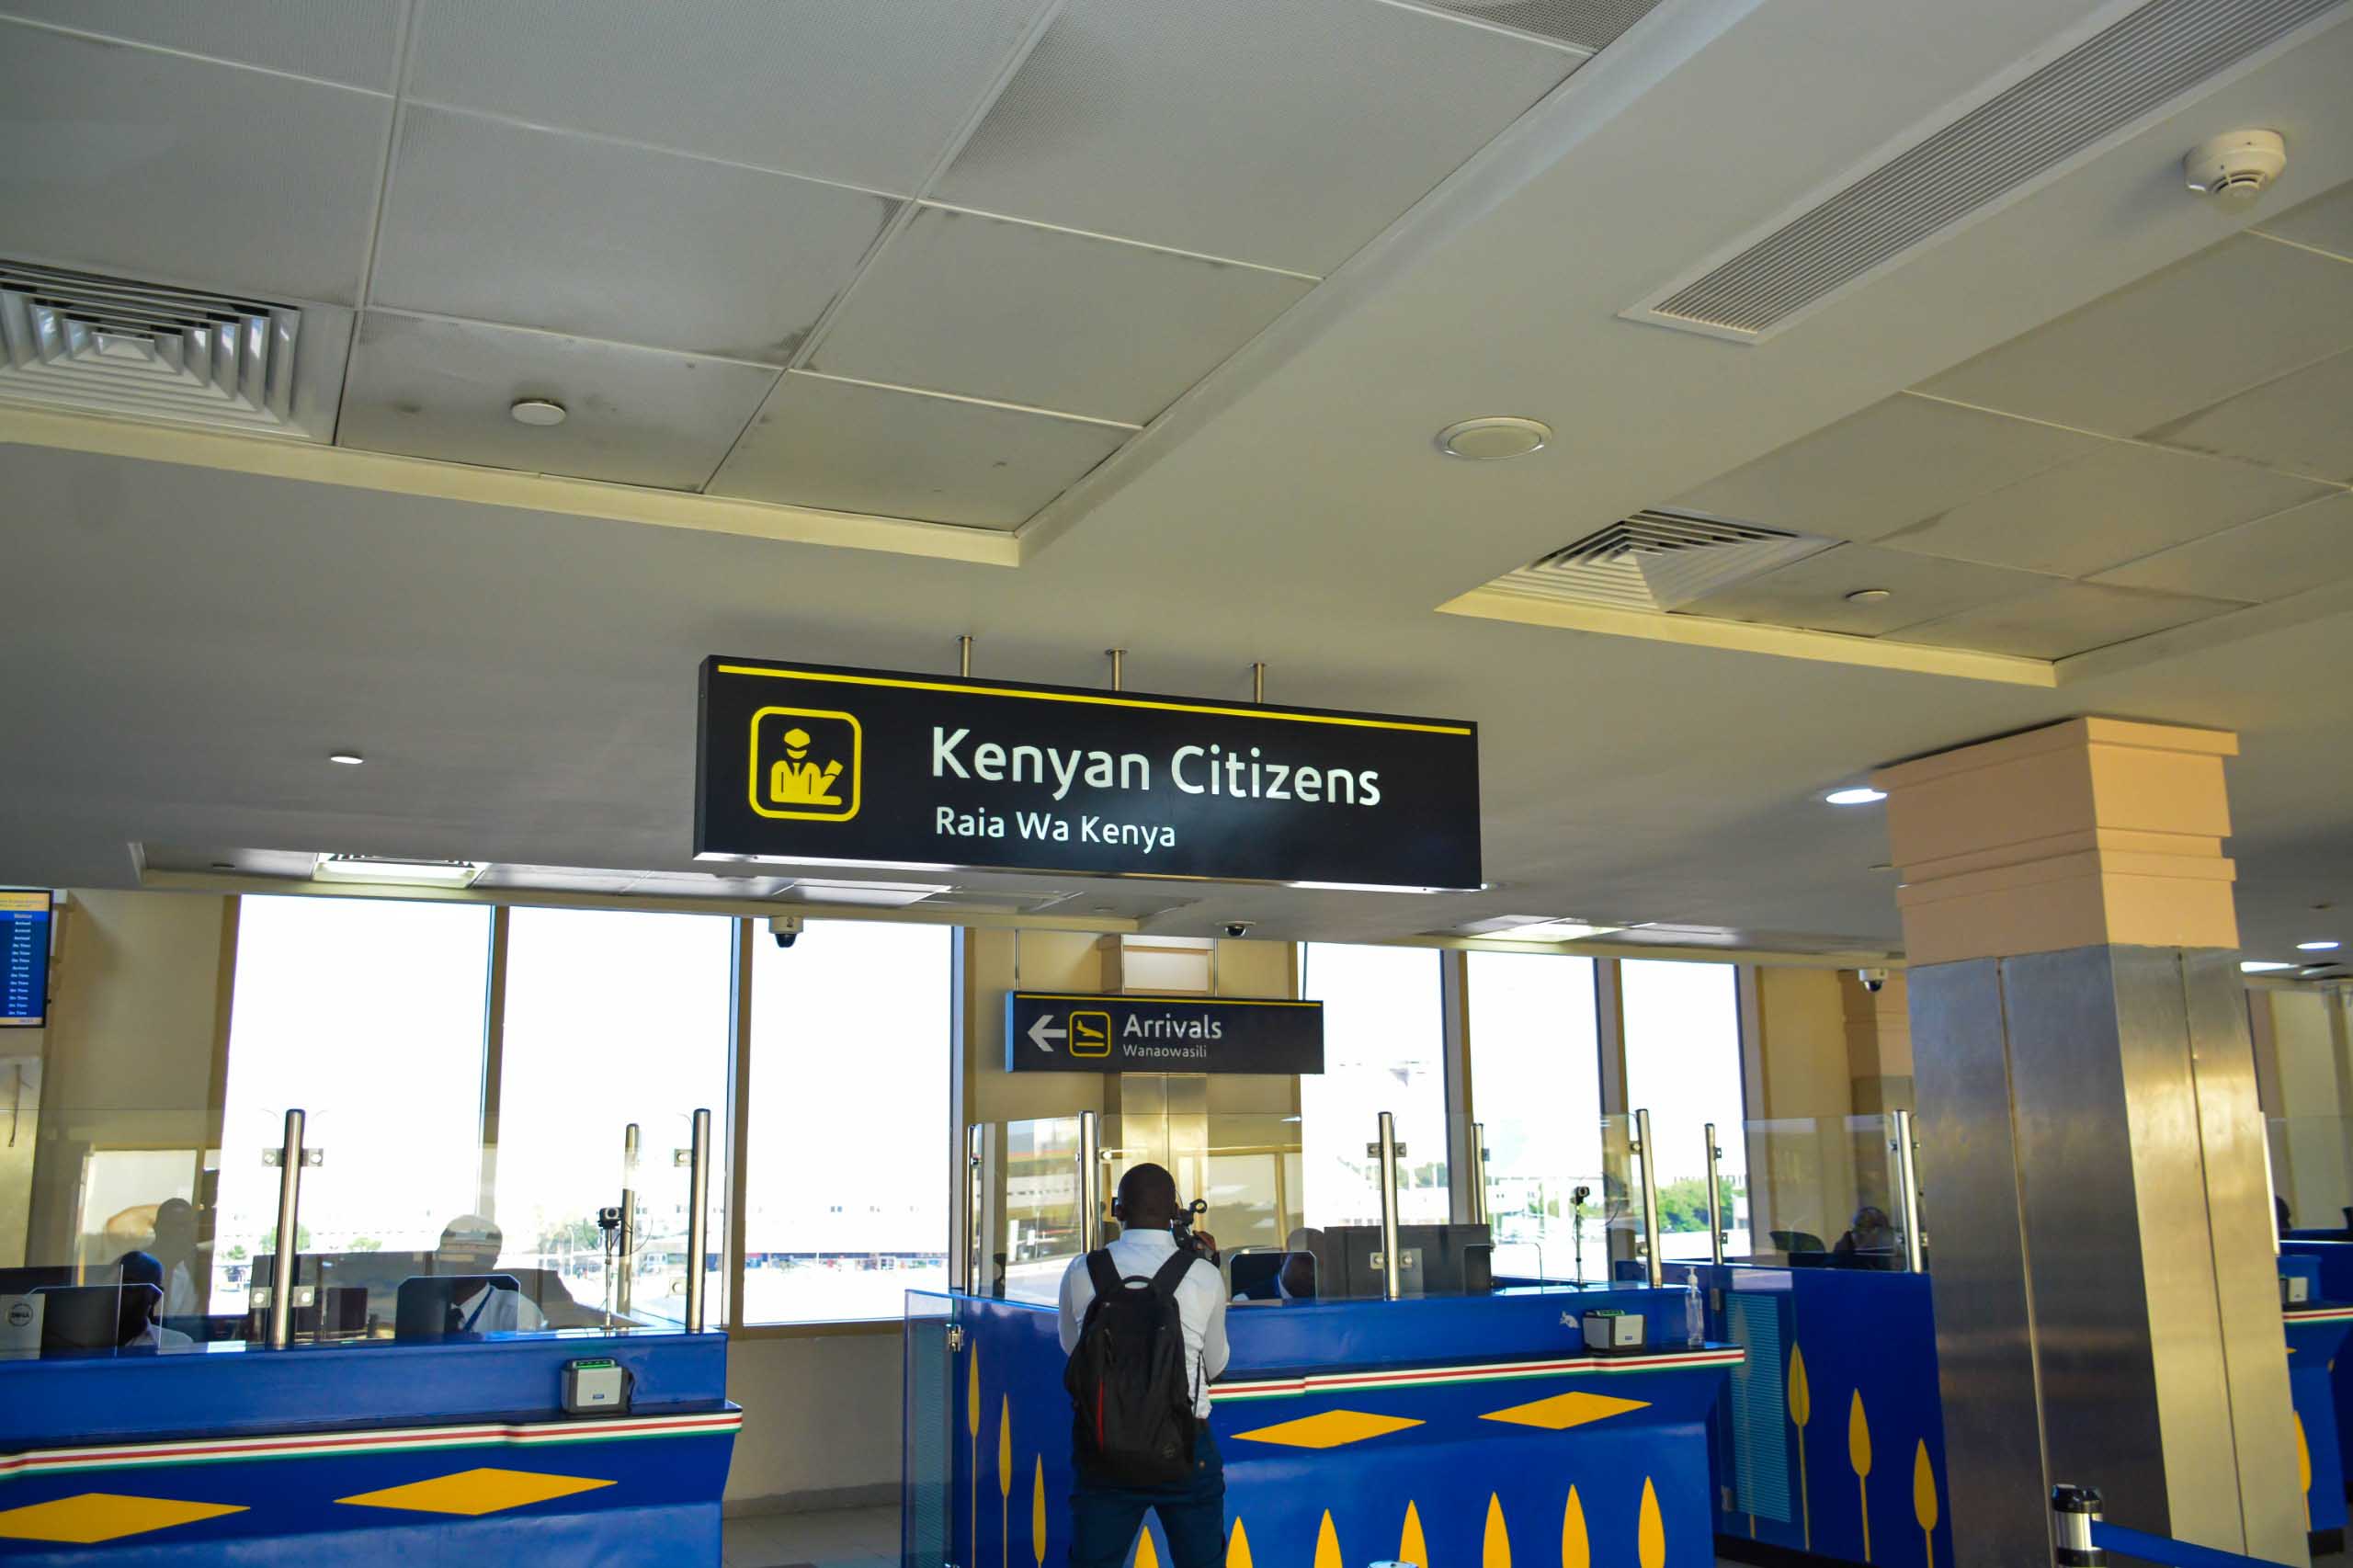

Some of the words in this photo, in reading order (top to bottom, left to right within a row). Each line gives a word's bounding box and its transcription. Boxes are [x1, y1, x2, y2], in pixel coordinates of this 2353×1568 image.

[933, 726, 1151, 801] Kenyan
[1171, 744, 1381, 807] Citizens
[936, 806, 1006, 840] Raia
[1015, 811, 1069, 843] Wa
[1081, 815, 1176, 855] Kenya
[1122, 1013, 1222, 1040] Arrivals
[1122, 1044, 1207, 1058] Wanaowasili
